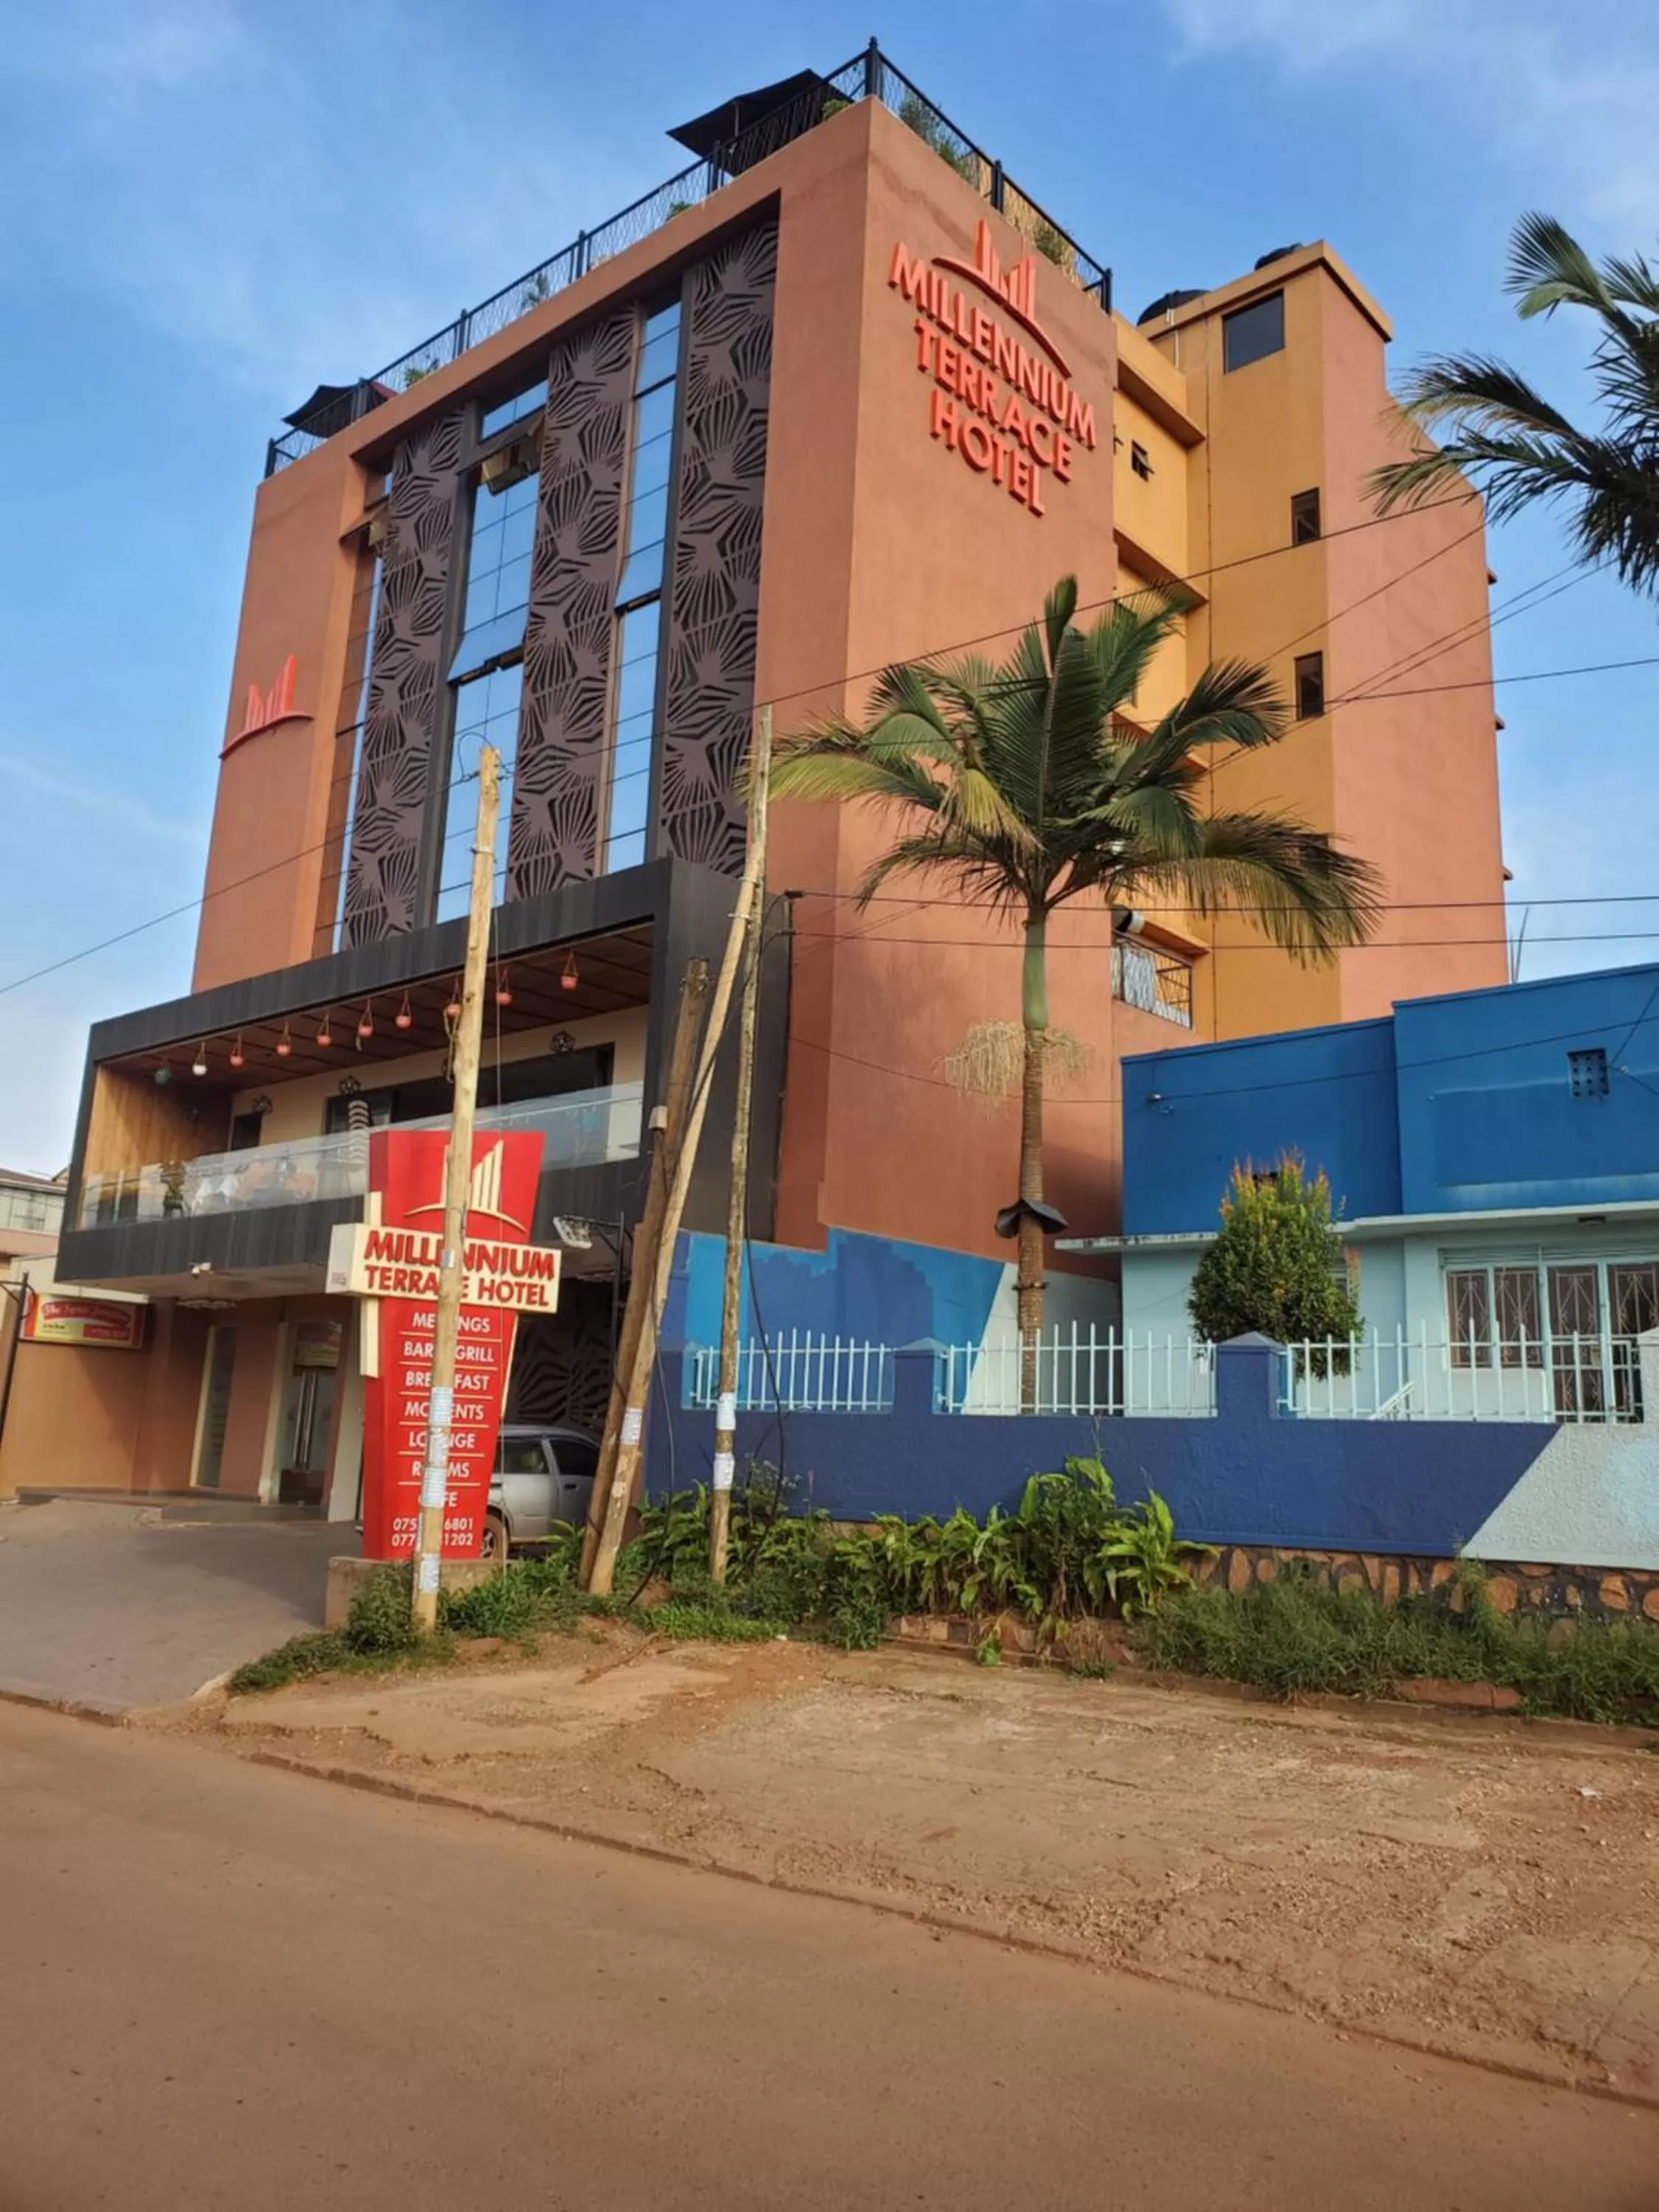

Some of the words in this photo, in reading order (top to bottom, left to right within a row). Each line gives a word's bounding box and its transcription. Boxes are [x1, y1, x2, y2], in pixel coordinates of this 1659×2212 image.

[888, 241, 1096, 451] MILLENNIUM
[914, 319, 1072, 484] TERRACE
[930, 389, 1046, 518] HOTEL
[365, 1265, 470, 1298] TERRAE
[478, 1278, 549, 1307] HOTEL
[412, 1312, 490, 1333] MENGS
[403, 1341, 434, 1357] BAR
[455, 1344, 495, 1363] GRILL
[406, 1370, 490, 1391] BREFAST
[408, 1430, 476, 1449] LOGE
[411, 1461, 470, 1478] RMS
